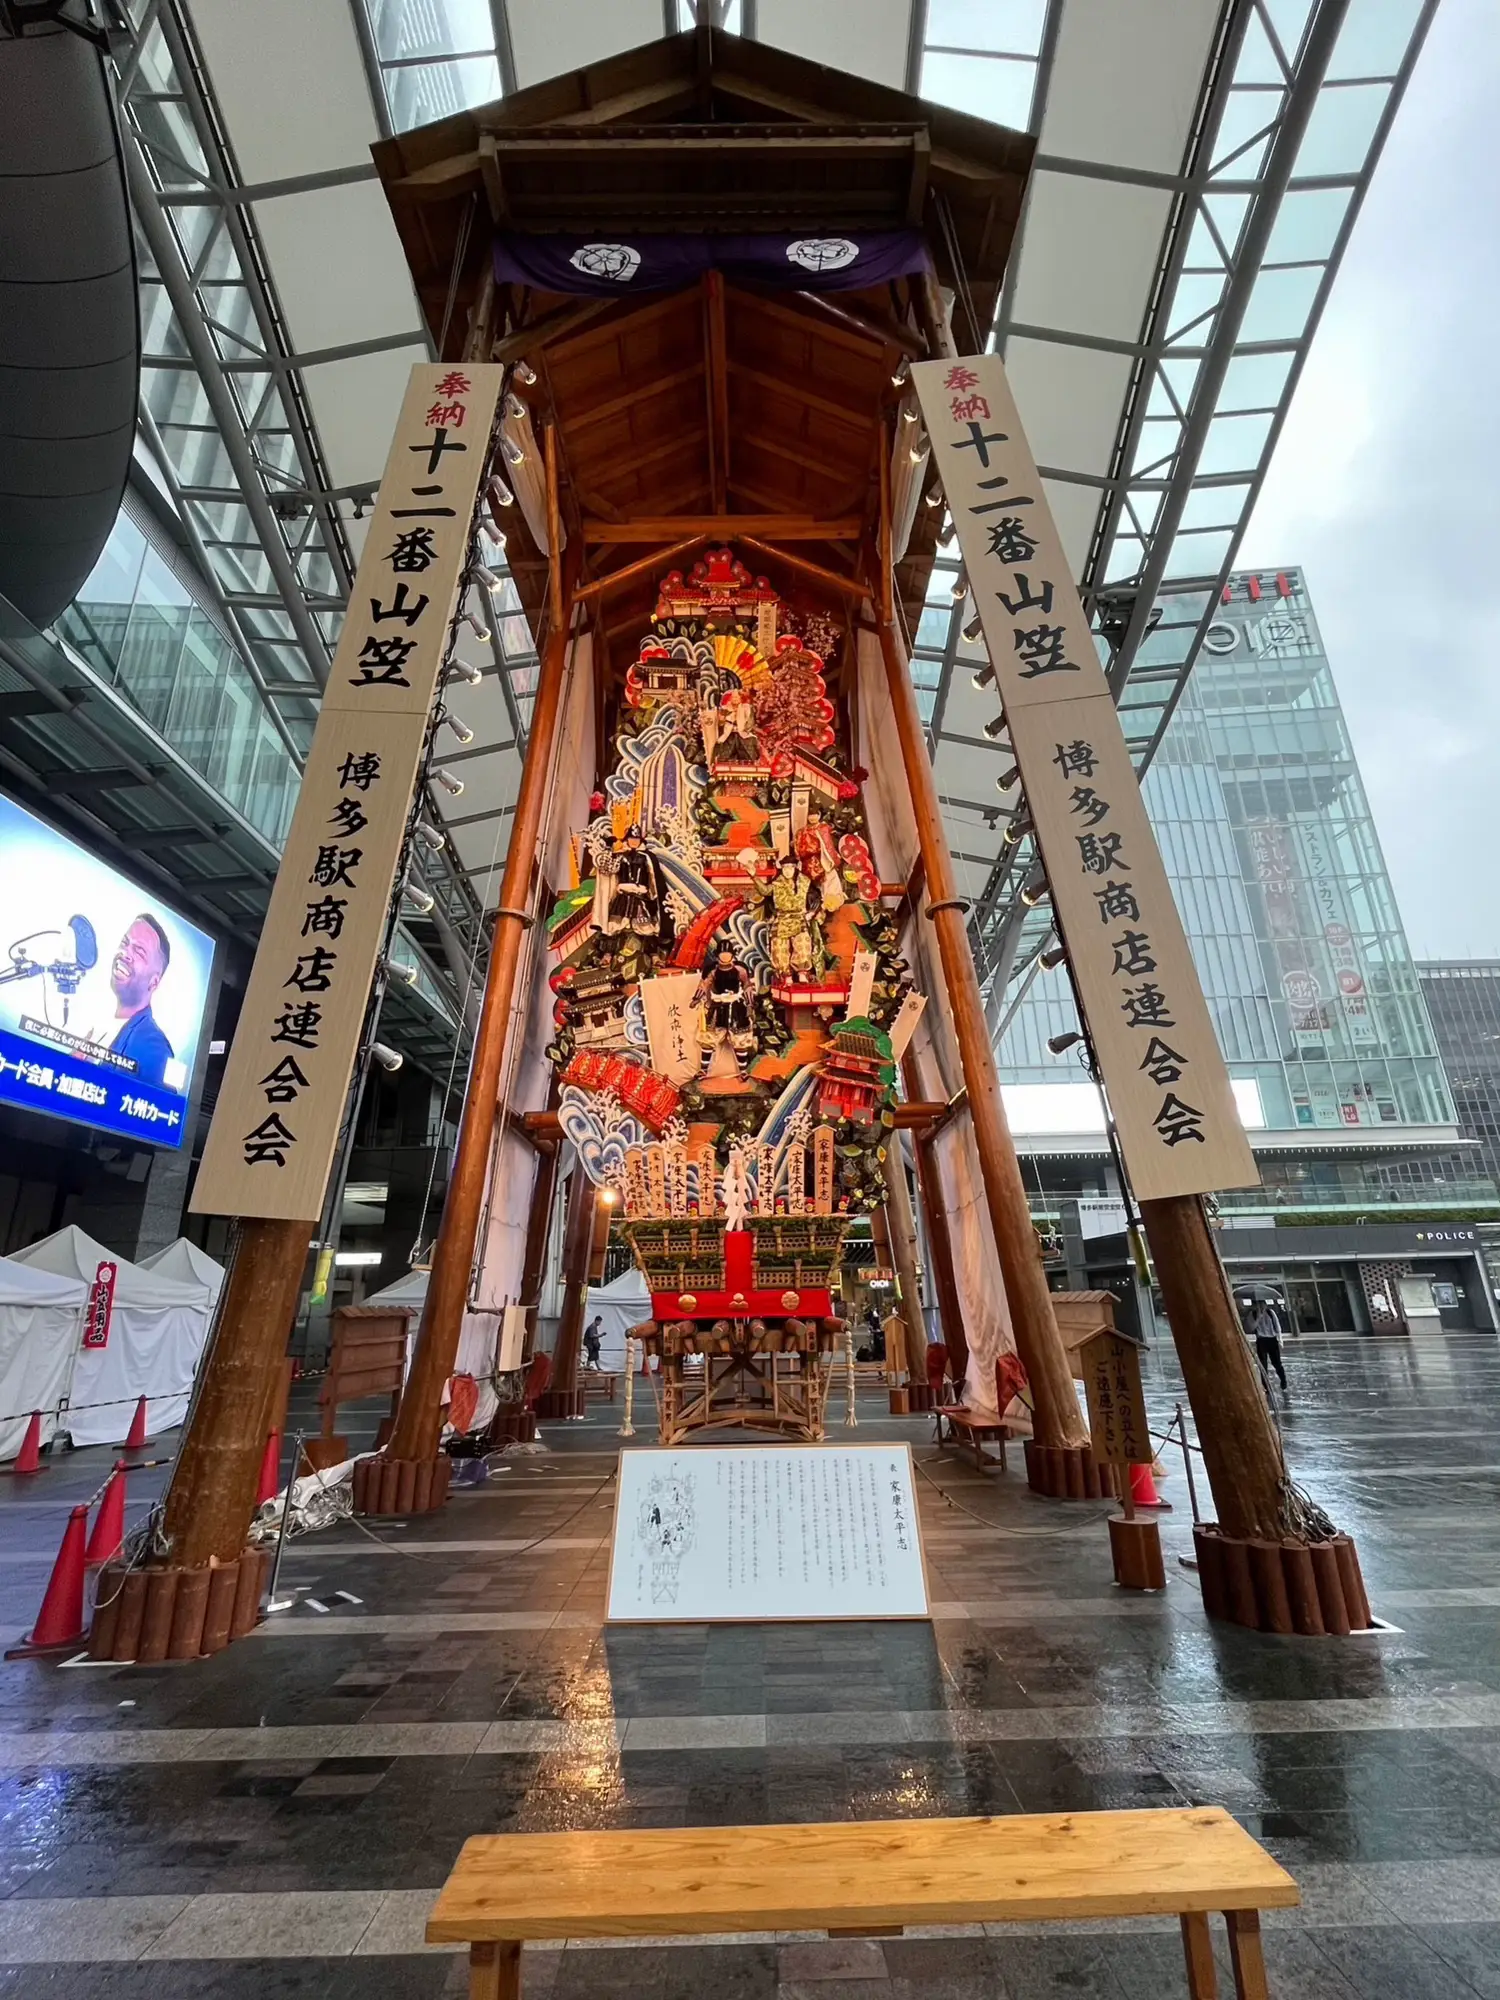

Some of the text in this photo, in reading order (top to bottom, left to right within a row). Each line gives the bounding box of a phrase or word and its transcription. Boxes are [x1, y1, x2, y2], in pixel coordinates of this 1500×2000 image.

[241, 371, 471, 1168] 奉納 十二番山笠 博多駅商店連合会
[943, 366, 1206, 1148] 奉納 十二番山笠 博多駅商店連合会
[119, 1094, 180, 1127] 九州カード
[817, 1138, 830, 1201] 家康太平志
[1426, 1231, 1475, 1241] POLICE
[89, 1283, 109, 1342] 山笠用品
[1096, 1360, 1119, 1457] ご遠慮下さい
[889, 1480, 908, 1551] 家康太平志
